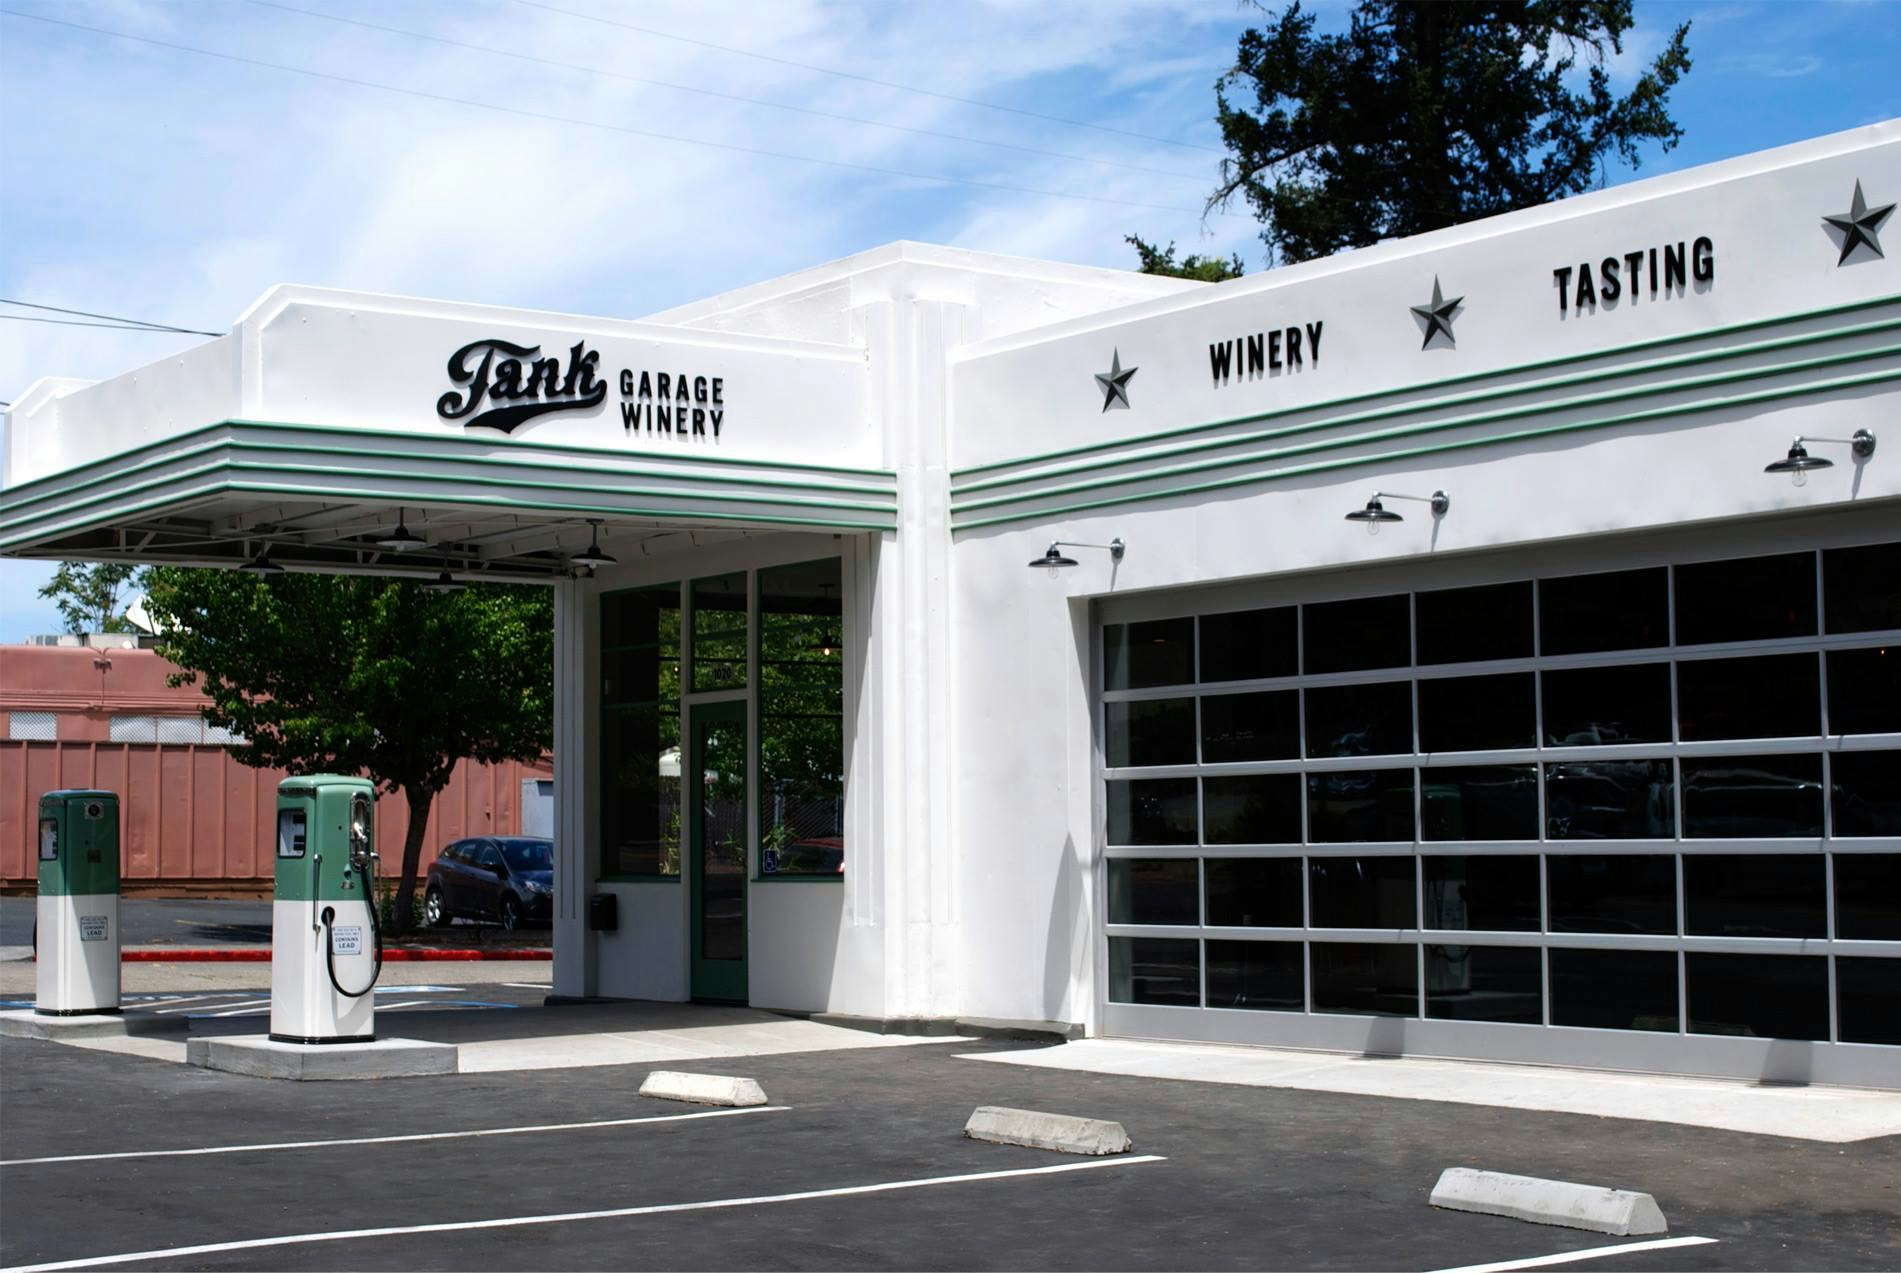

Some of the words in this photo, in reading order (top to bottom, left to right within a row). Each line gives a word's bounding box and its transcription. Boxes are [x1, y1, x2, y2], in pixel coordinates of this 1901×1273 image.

[1553, 236, 1714, 310] TASTING
[1209, 320, 1323, 380] WINERY
[437, 339, 608, 434] Tank
[620, 368, 724, 404] GARAGE
[620, 402, 724, 437] WINERY
